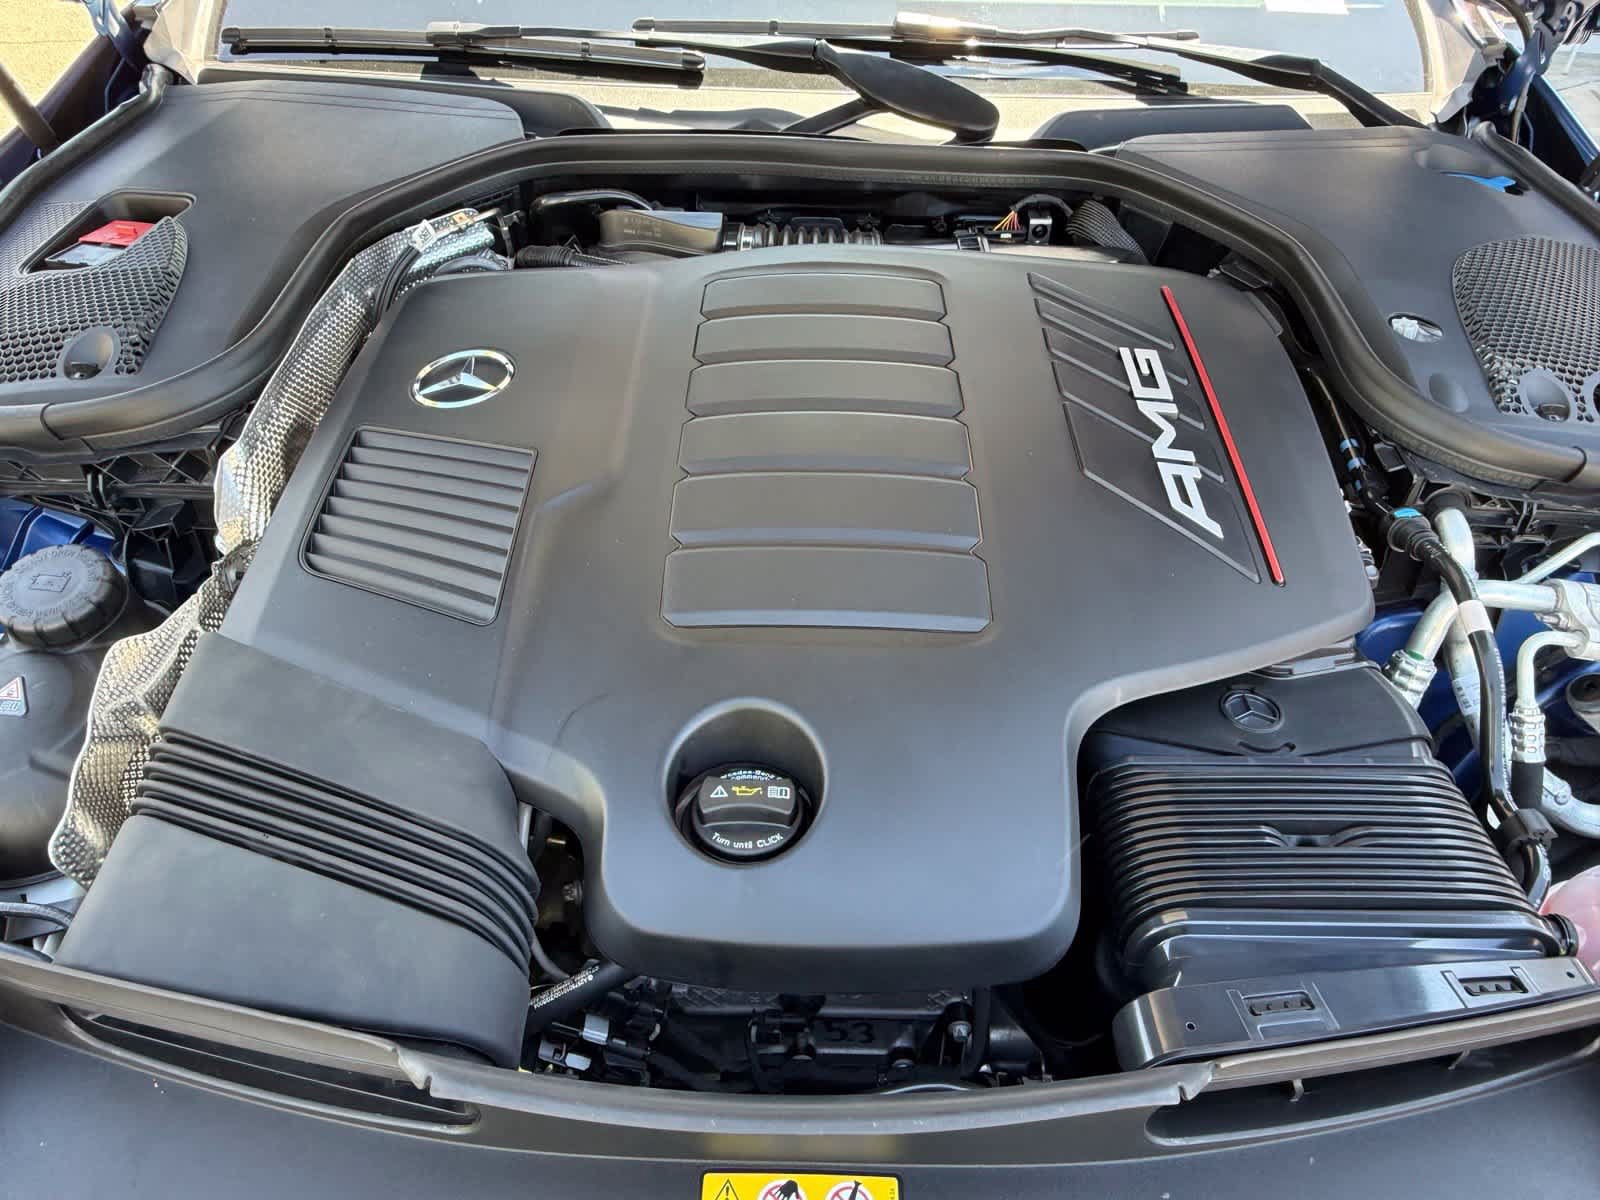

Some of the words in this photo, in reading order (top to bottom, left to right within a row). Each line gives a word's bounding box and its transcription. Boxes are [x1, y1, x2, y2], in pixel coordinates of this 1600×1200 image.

[1119, 347, 1224, 538] AMG
[712, 832, 730, 847] Turn
[733, 840, 753, 849] until
[756, 833, 784, 848] CLICK
[823, 1021, 876, 1043] 53
